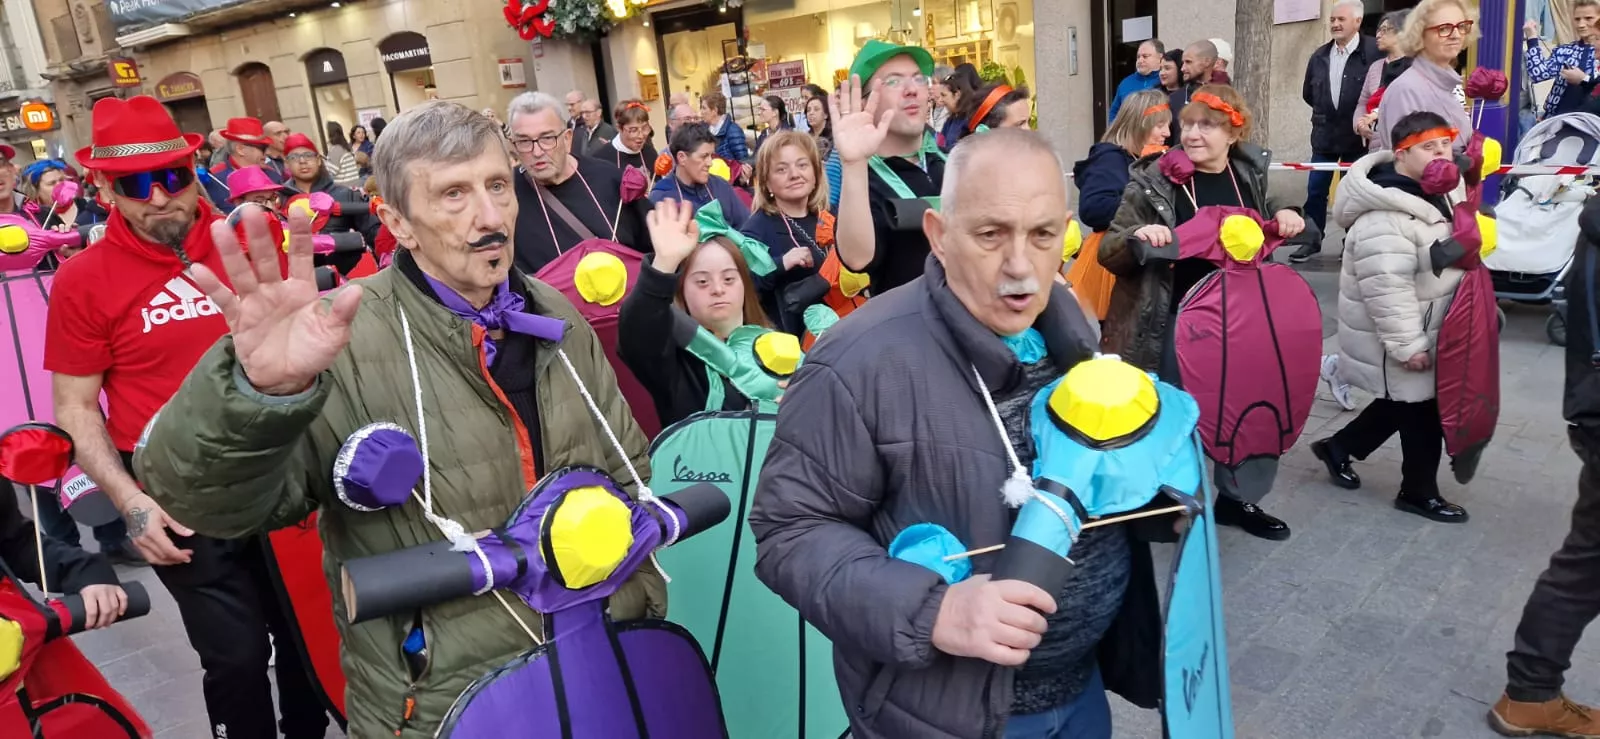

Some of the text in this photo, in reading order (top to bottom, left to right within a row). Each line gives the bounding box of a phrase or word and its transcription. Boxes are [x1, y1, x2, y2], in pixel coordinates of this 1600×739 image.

[120, 0, 141, 14] Peak
[141, 295, 223, 333] jodid
[670, 454, 733, 483] Vespa
